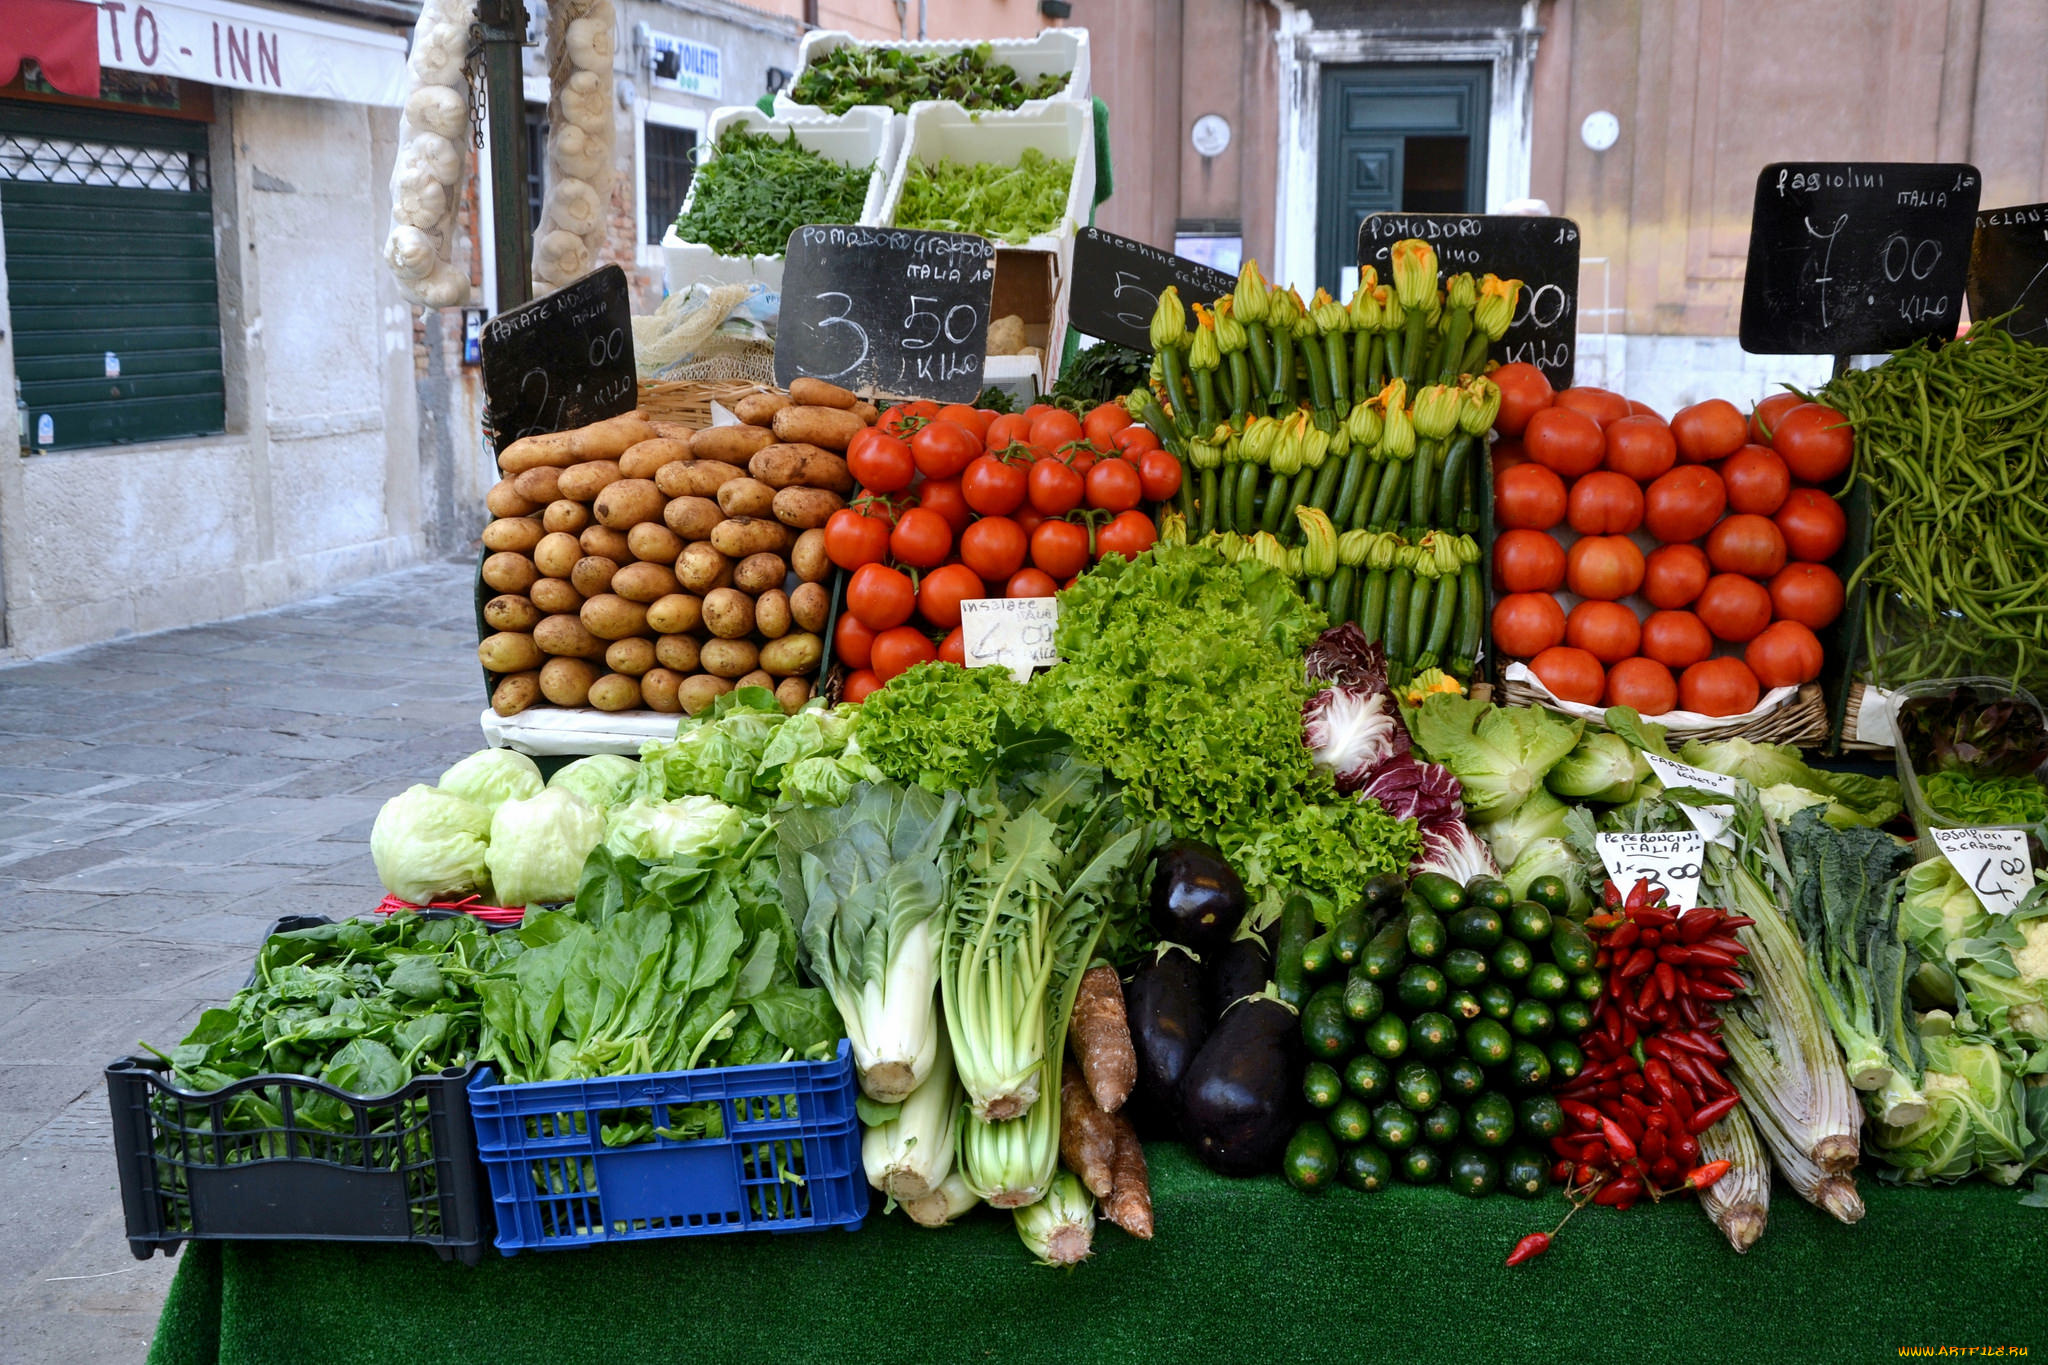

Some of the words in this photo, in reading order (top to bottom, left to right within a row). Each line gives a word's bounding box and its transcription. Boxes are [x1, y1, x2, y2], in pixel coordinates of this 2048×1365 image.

[101, 2, 159, 67] TO
[212, 22, 282, 87] INN
[677, 42, 719, 80] TOILETTE
[1897, 190, 1948, 209] ITALIA
[1370, 218, 1483, 241] POMODORO
[907, 263, 961, 283] ITALIA
[1884, 234, 1942, 283] 00
[1113, 270, 1160, 329] 5
[1899, 295, 1949, 325] KILO
[491, 303, 552, 343] PATATE
[796, 291, 869, 380] 3
[902, 294, 978, 349] 50
[588, 327, 624, 367] 00
[1506, 339, 1569, 371] KILO
[917, 352, 979, 383] KILO
[594, 374, 631, 407] KILO
[1603, 831, 1701, 844] PEPERONCINI
[1620, 842, 1680, 855] ITALIA
[1666, 862, 1701, 880] 00
[1974, 857, 2016, 903] 4
[2000, 857, 2026, 876] 00
